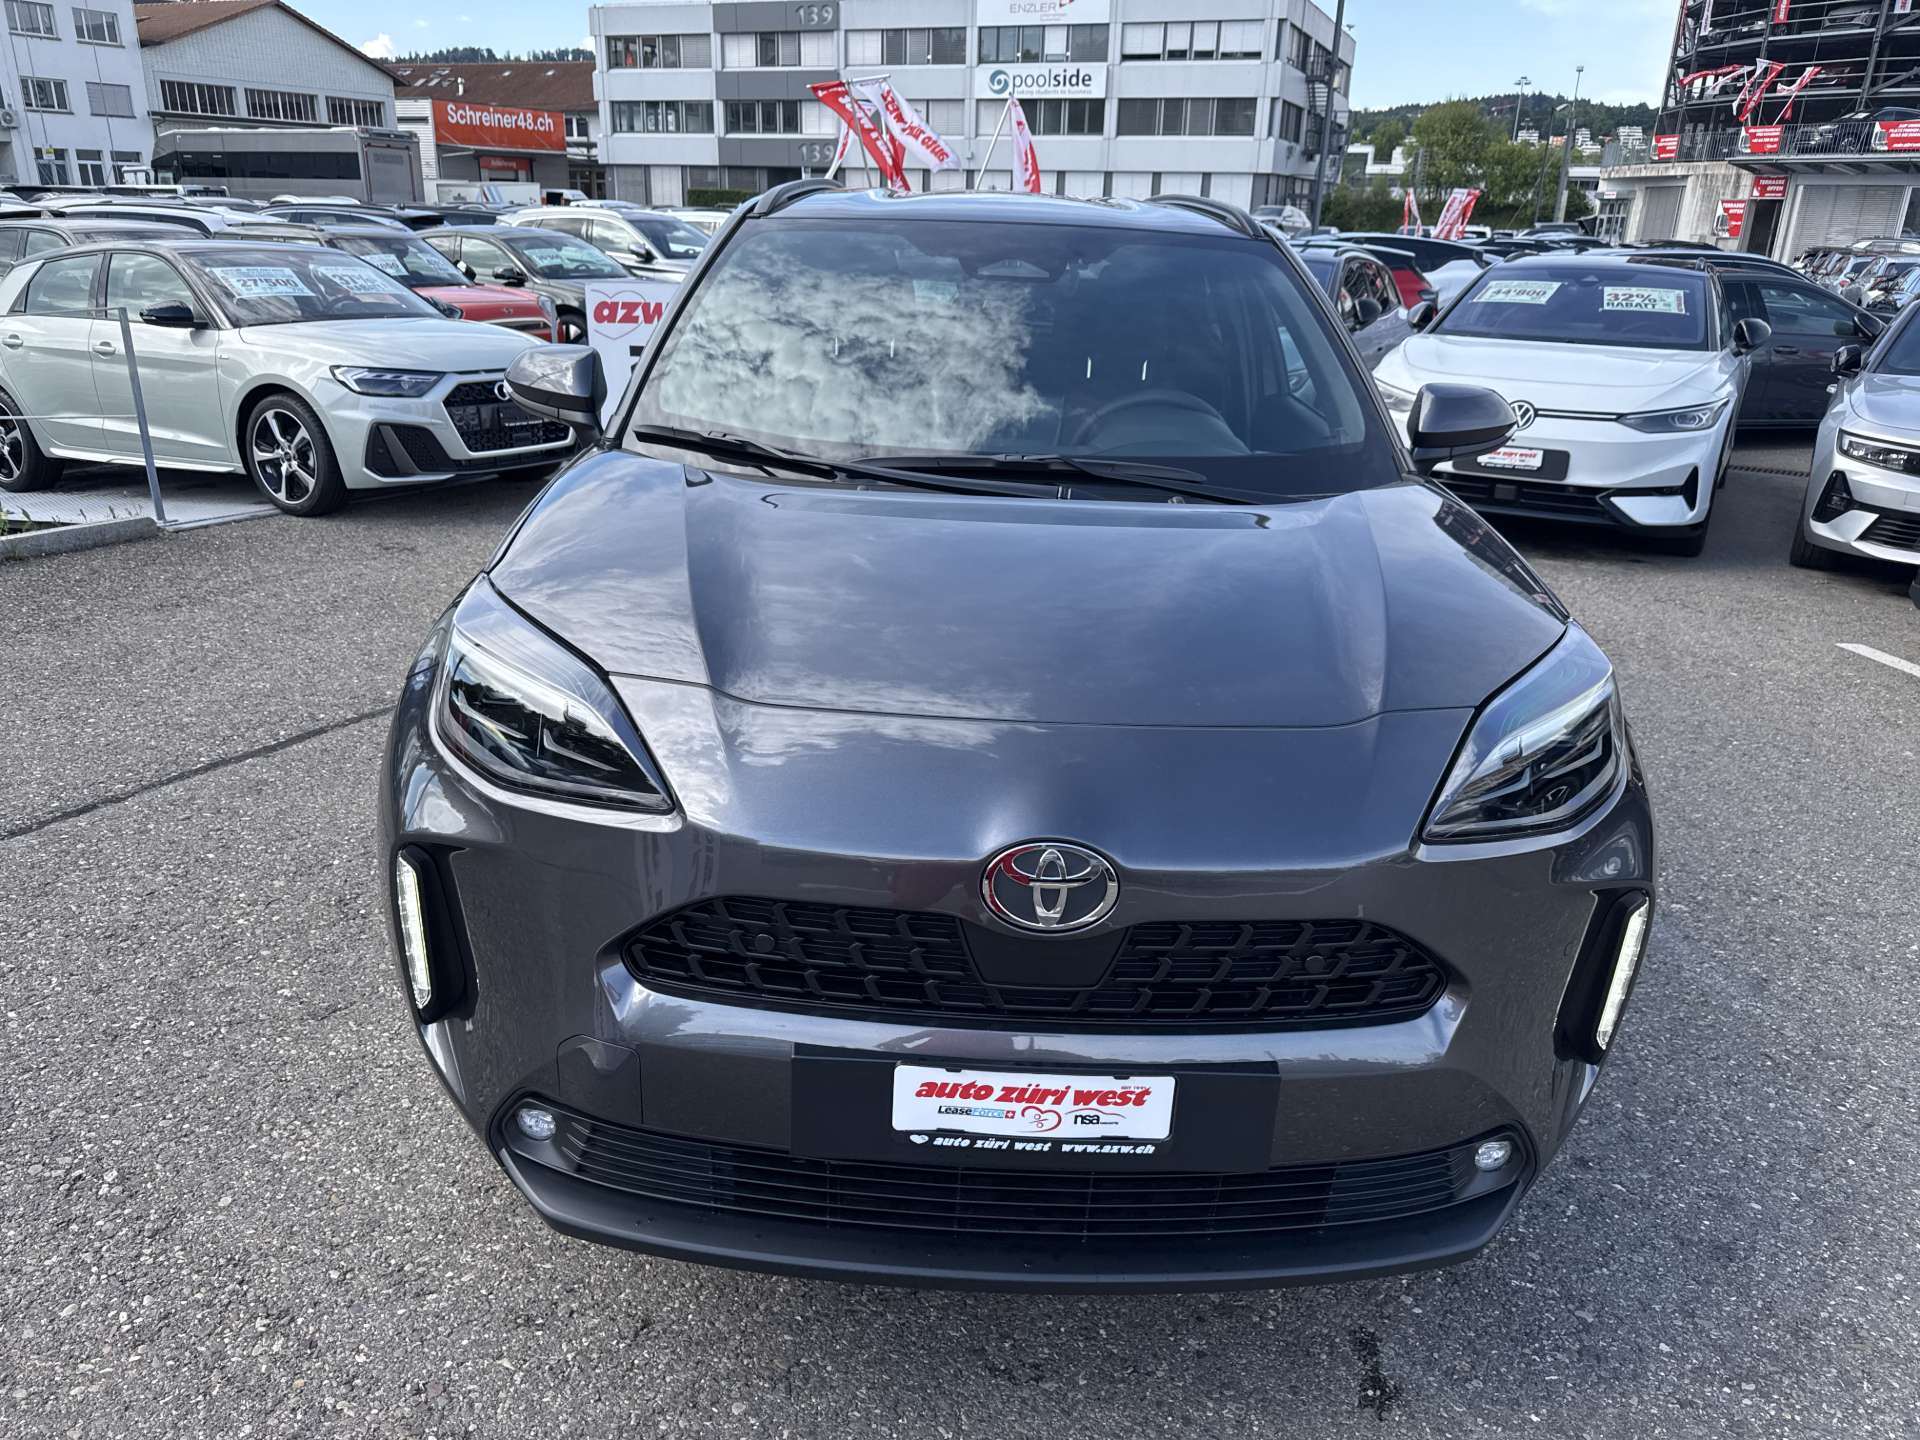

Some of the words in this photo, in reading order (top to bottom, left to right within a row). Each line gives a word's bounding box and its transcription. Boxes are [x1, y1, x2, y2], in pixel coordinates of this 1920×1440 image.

[796, 6, 833, 25] 139
[1010, 2, 1056, 14] ENZLER
[1012, 68, 1092, 95] poolside
[447, 103, 554, 132] Schreiner48.ch
[799, 144, 834, 164] 139
[236, 278, 299, 288] 27'500
[1606, 292, 1657, 303] 32%
[915, 1080, 993, 1100] auto
[995, 1084, 1071, 1105] züri
[1072, 1086, 1152, 1106] west
[937, 1105, 1005, 1118] LeaseForce
[1073, 1114, 1100, 1125] nsa
[933, 1136, 970, 1147] auto
[973, 1138, 1010, 1150] züri
[1013, 1141, 1051, 1152] west
[1061, 1142, 1155, 1154] www.azw.ch
